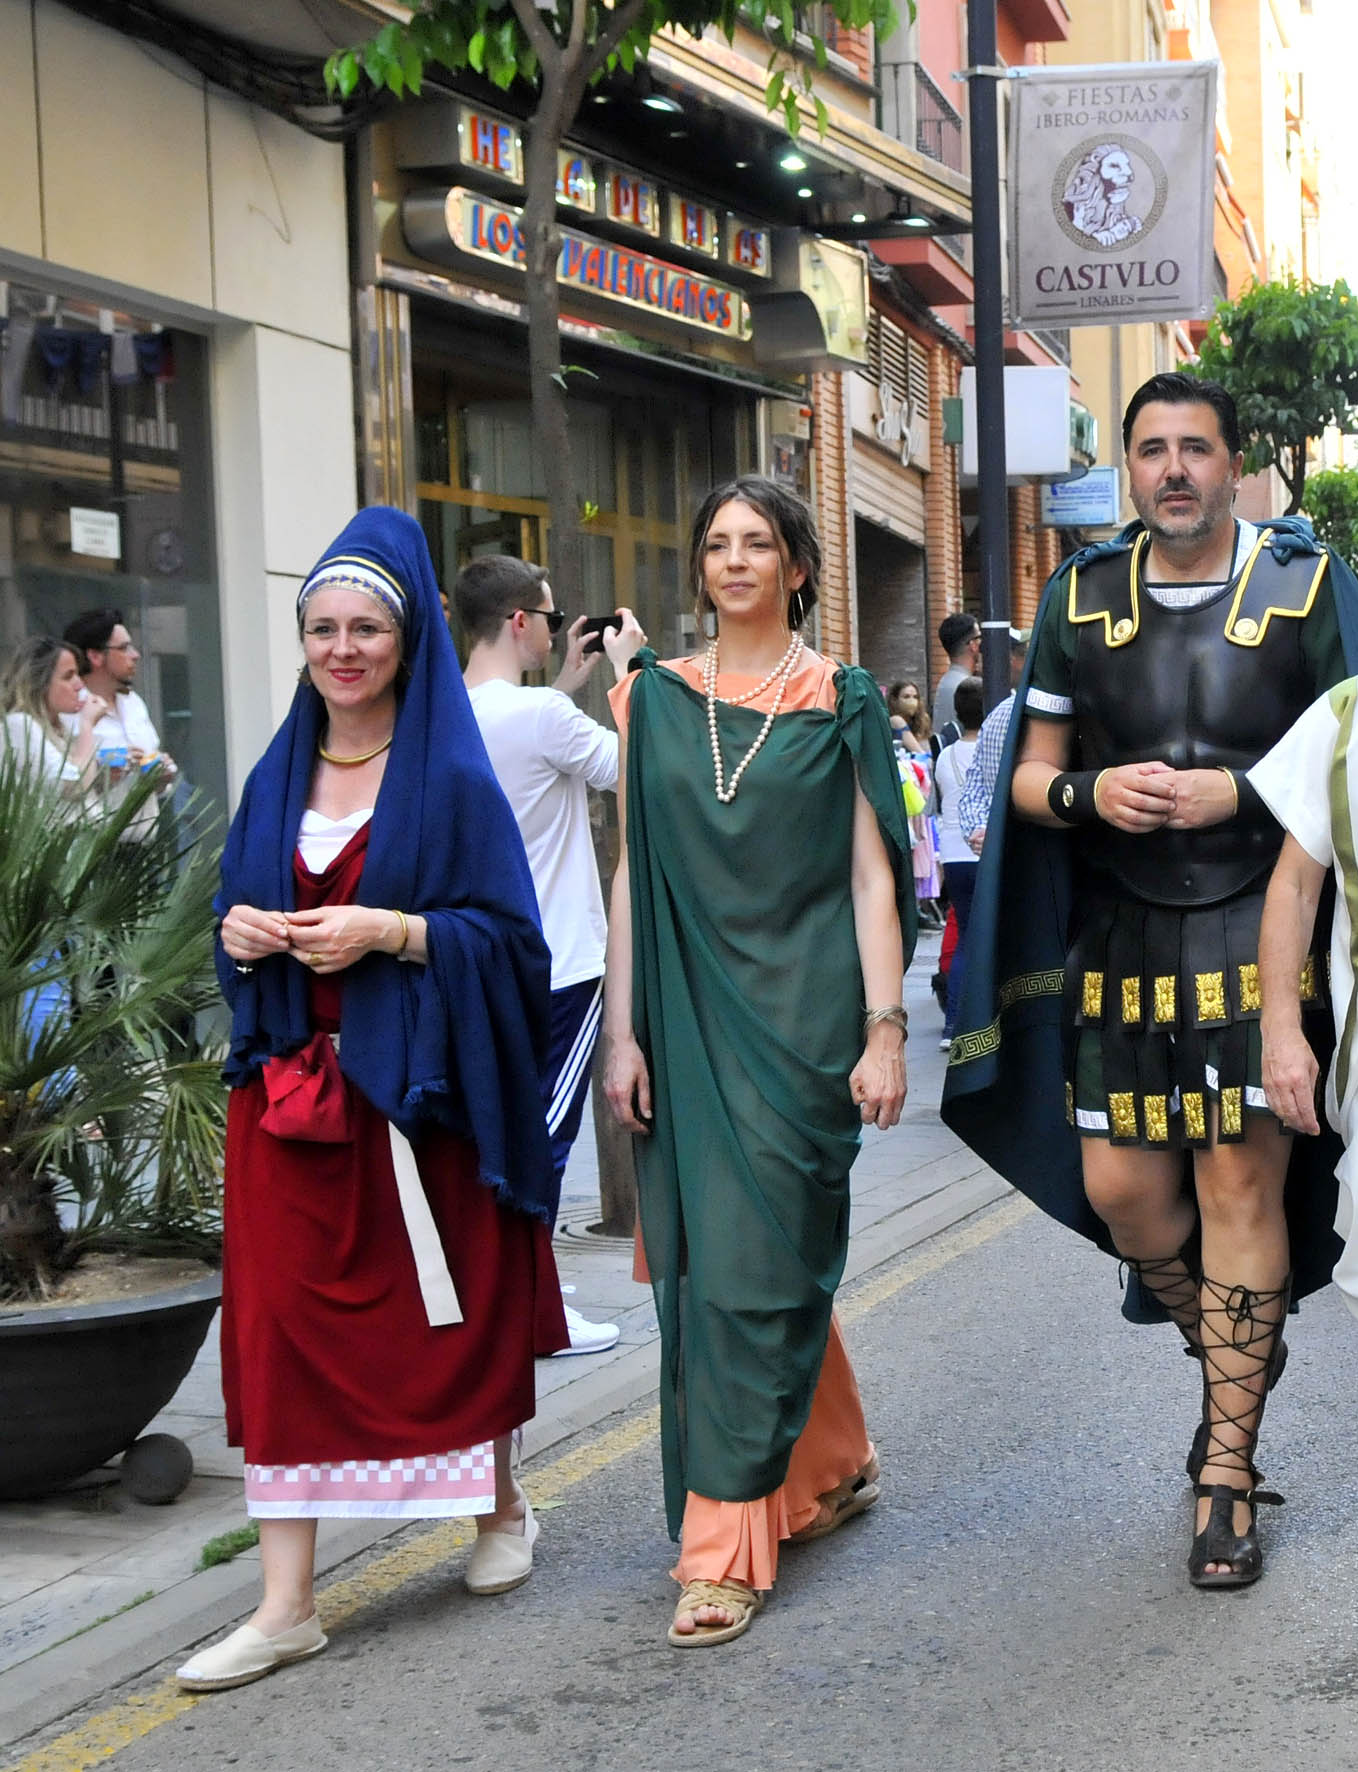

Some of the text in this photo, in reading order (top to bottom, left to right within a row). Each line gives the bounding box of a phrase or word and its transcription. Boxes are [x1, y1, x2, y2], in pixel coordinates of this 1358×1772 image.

[1066, 83, 1159, 107] FIESTAS
[1036, 106, 1190, 129] IBERO-ROMANAS
[562, 237, 732, 329] VALENCIANOS
[1035, 259, 1180, 293] CASTVLO
[1080, 294, 1135, 308] LINARES
